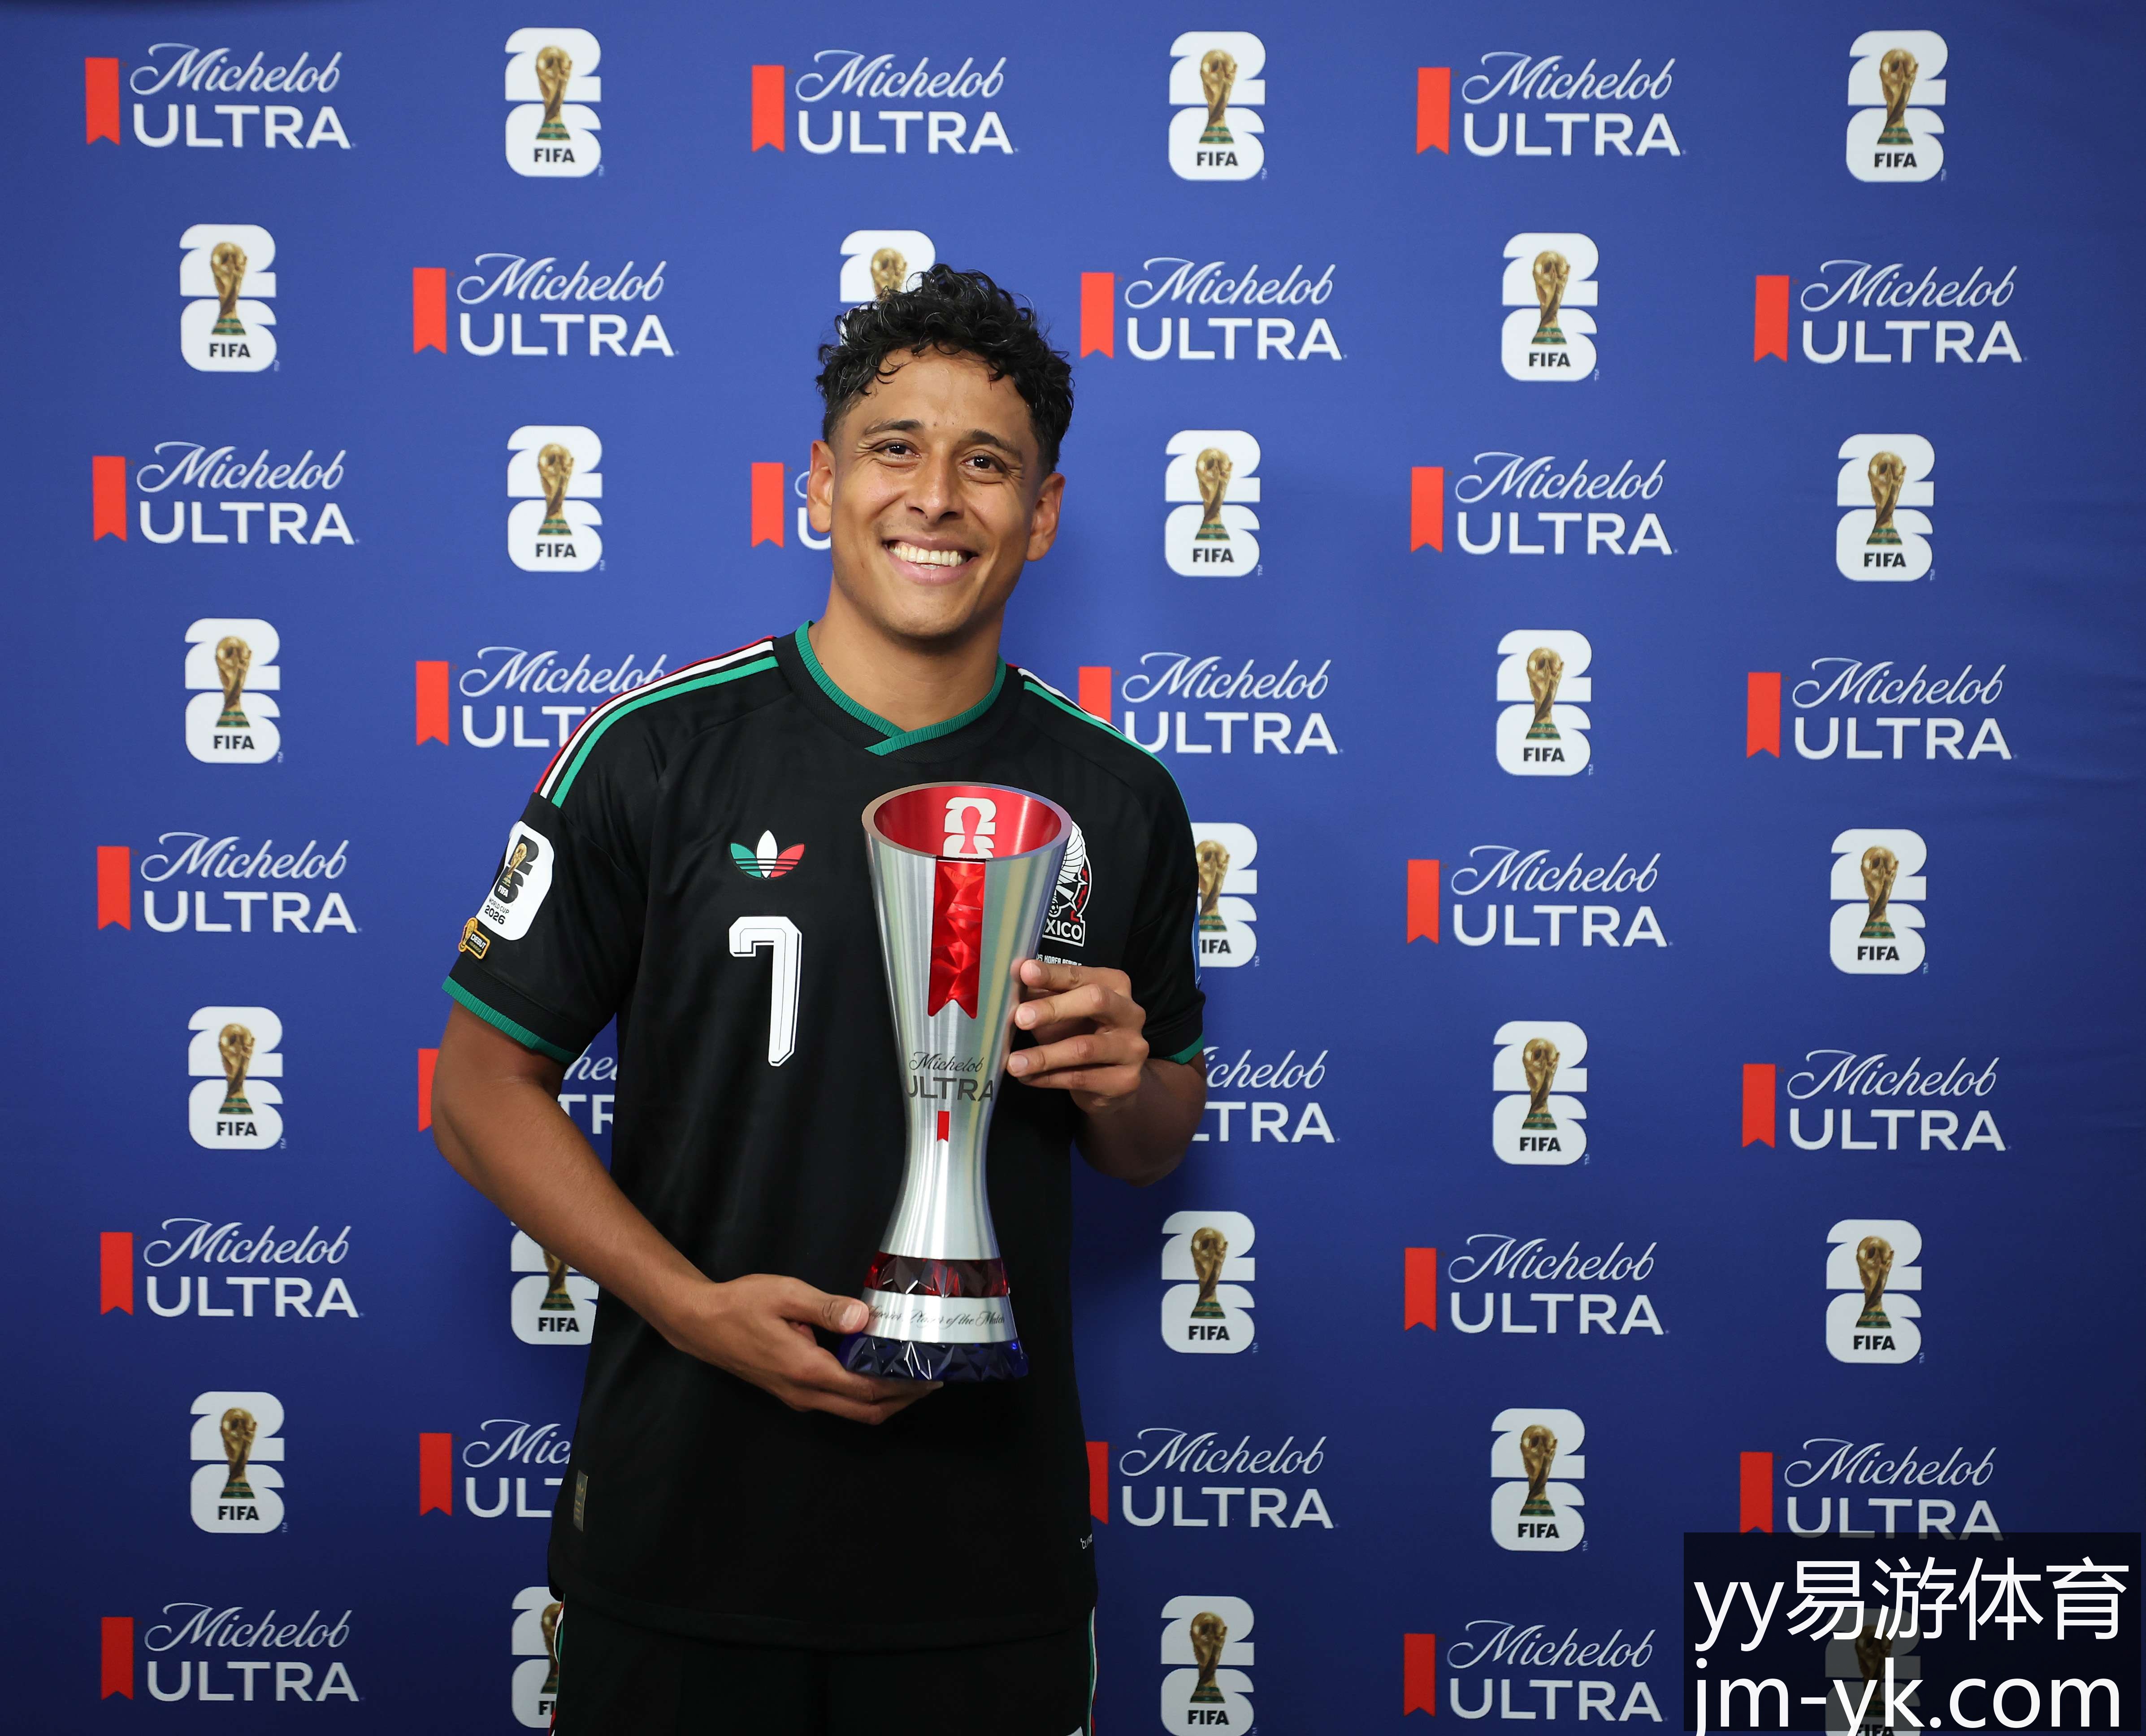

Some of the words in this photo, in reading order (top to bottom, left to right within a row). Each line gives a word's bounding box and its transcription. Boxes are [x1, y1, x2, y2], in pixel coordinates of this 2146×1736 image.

[130, 43, 342, 95] Michelob
[796, 50, 1006, 102] Michelob
[1462, 52, 1675, 104] Michelob
[134, 104, 351, 149] ULTRA
[798, 110, 1014, 154] ULTRA
[1464, 113, 1681, 156] ULTRA
[535, 149, 574, 162] FIFA
[1197, 152, 1237, 165] FIFA
[1875, 153, 1916, 167] FIFA
[457, 253, 666, 304] Michelob
[1124, 257, 1335, 308] Michelob
[1801, 260, 2017, 312] Michelob
[210, 343, 250, 357] FIFA
[460, 313, 674, 356] ULTRA
[1127, 317, 1342, 360] ULTRA
[1803, 321, 2022, 364] ULTRA
[1529, 353, 1570, 366] FIFA
[137, 442, 346, 492] Michelob
[1456, 452, 1666, 503] Michelob
[140, 501, 354, 545] ULTRA
[1457, 512, 1672, 555] ULTRA
[537, 544, 576, 557] FIFA
[1193, 549, 1234, 562] FIFA
[1864, 553, 1906, 567] FIFA
[1123, 652, 1331, 703] Michelob
[1793, 658, 2006, 708] Michelob
[214, 736, 254, 749] FIFA
[462, 705, 600, 748] ULT
[1125, 711, 1338, 754] ULTRA
[1795, 717, 2012, 760] ULTRA
[1524, 748, 1565, 761] FIFA
[141, 832, 348, 881] Michelob
[1452, 845, 1660, 895] Michelob
[144, 890, 357, 933] ULTRA
[489, 898, 500, 909] WORLD
[500, 906, 510, 915] CUP
[498, 885, 509, 897] FIFA
[485, 905, 506, 924] 2026
[1045, 918, 1082, 940] XICO
[1453, 904, 1667, 947] ULTRA
[1200, 939, 1232, 954] IFA
[1858, 946, 1899, 960] FIFA
[729, 916, 802, 1067] 7
[909, 1052, 984, 1072] Michelob
[1203, 1047, 1328, 1089] chelob
[1787, 1050, 1999, 1099] Michelob
[217, 1122, 257, 1136] FIFA
[1192, 1102, 1335, 1143] TRA
[1520, 1137, 1561, 1151] FIFA
[1790, 1108, 2006, 1151] ULTRA
[143, 1218, 351, 1267] Michelob
[1449, 1234, 1656, 1283] Michelob
[147, 1276, 359, 1318] ULTRA
[1451, 1292, 1664, 1335] ULTRA
[538, 1317, 579, 1332] FIFA
[1189, 1326, 1230, 1340] FIFA
[1854, 1336, 1895, 1350] FIFA
[1120, 1428, 1326, 1476] Michelob
[1785, 1438, 1996, 1487] Michelob
[218, 1506, 259, 1520] FIFA
[1123, 1486, 1333, 1528] ULTRA
[1787, 1497, 2004, 1541] ULTRA
[1518, 1523, 1559, 1538] FIFA
[145, 1603, 352, 1651] Michelob
[1448, 1620, 1655, 1668] Michelob
[148, 1661, 359, 1701] ULTRA
[1450, 1678, 1663, 1722] ULTRA
[1188, 1710, 1229, 1725] FIFA
